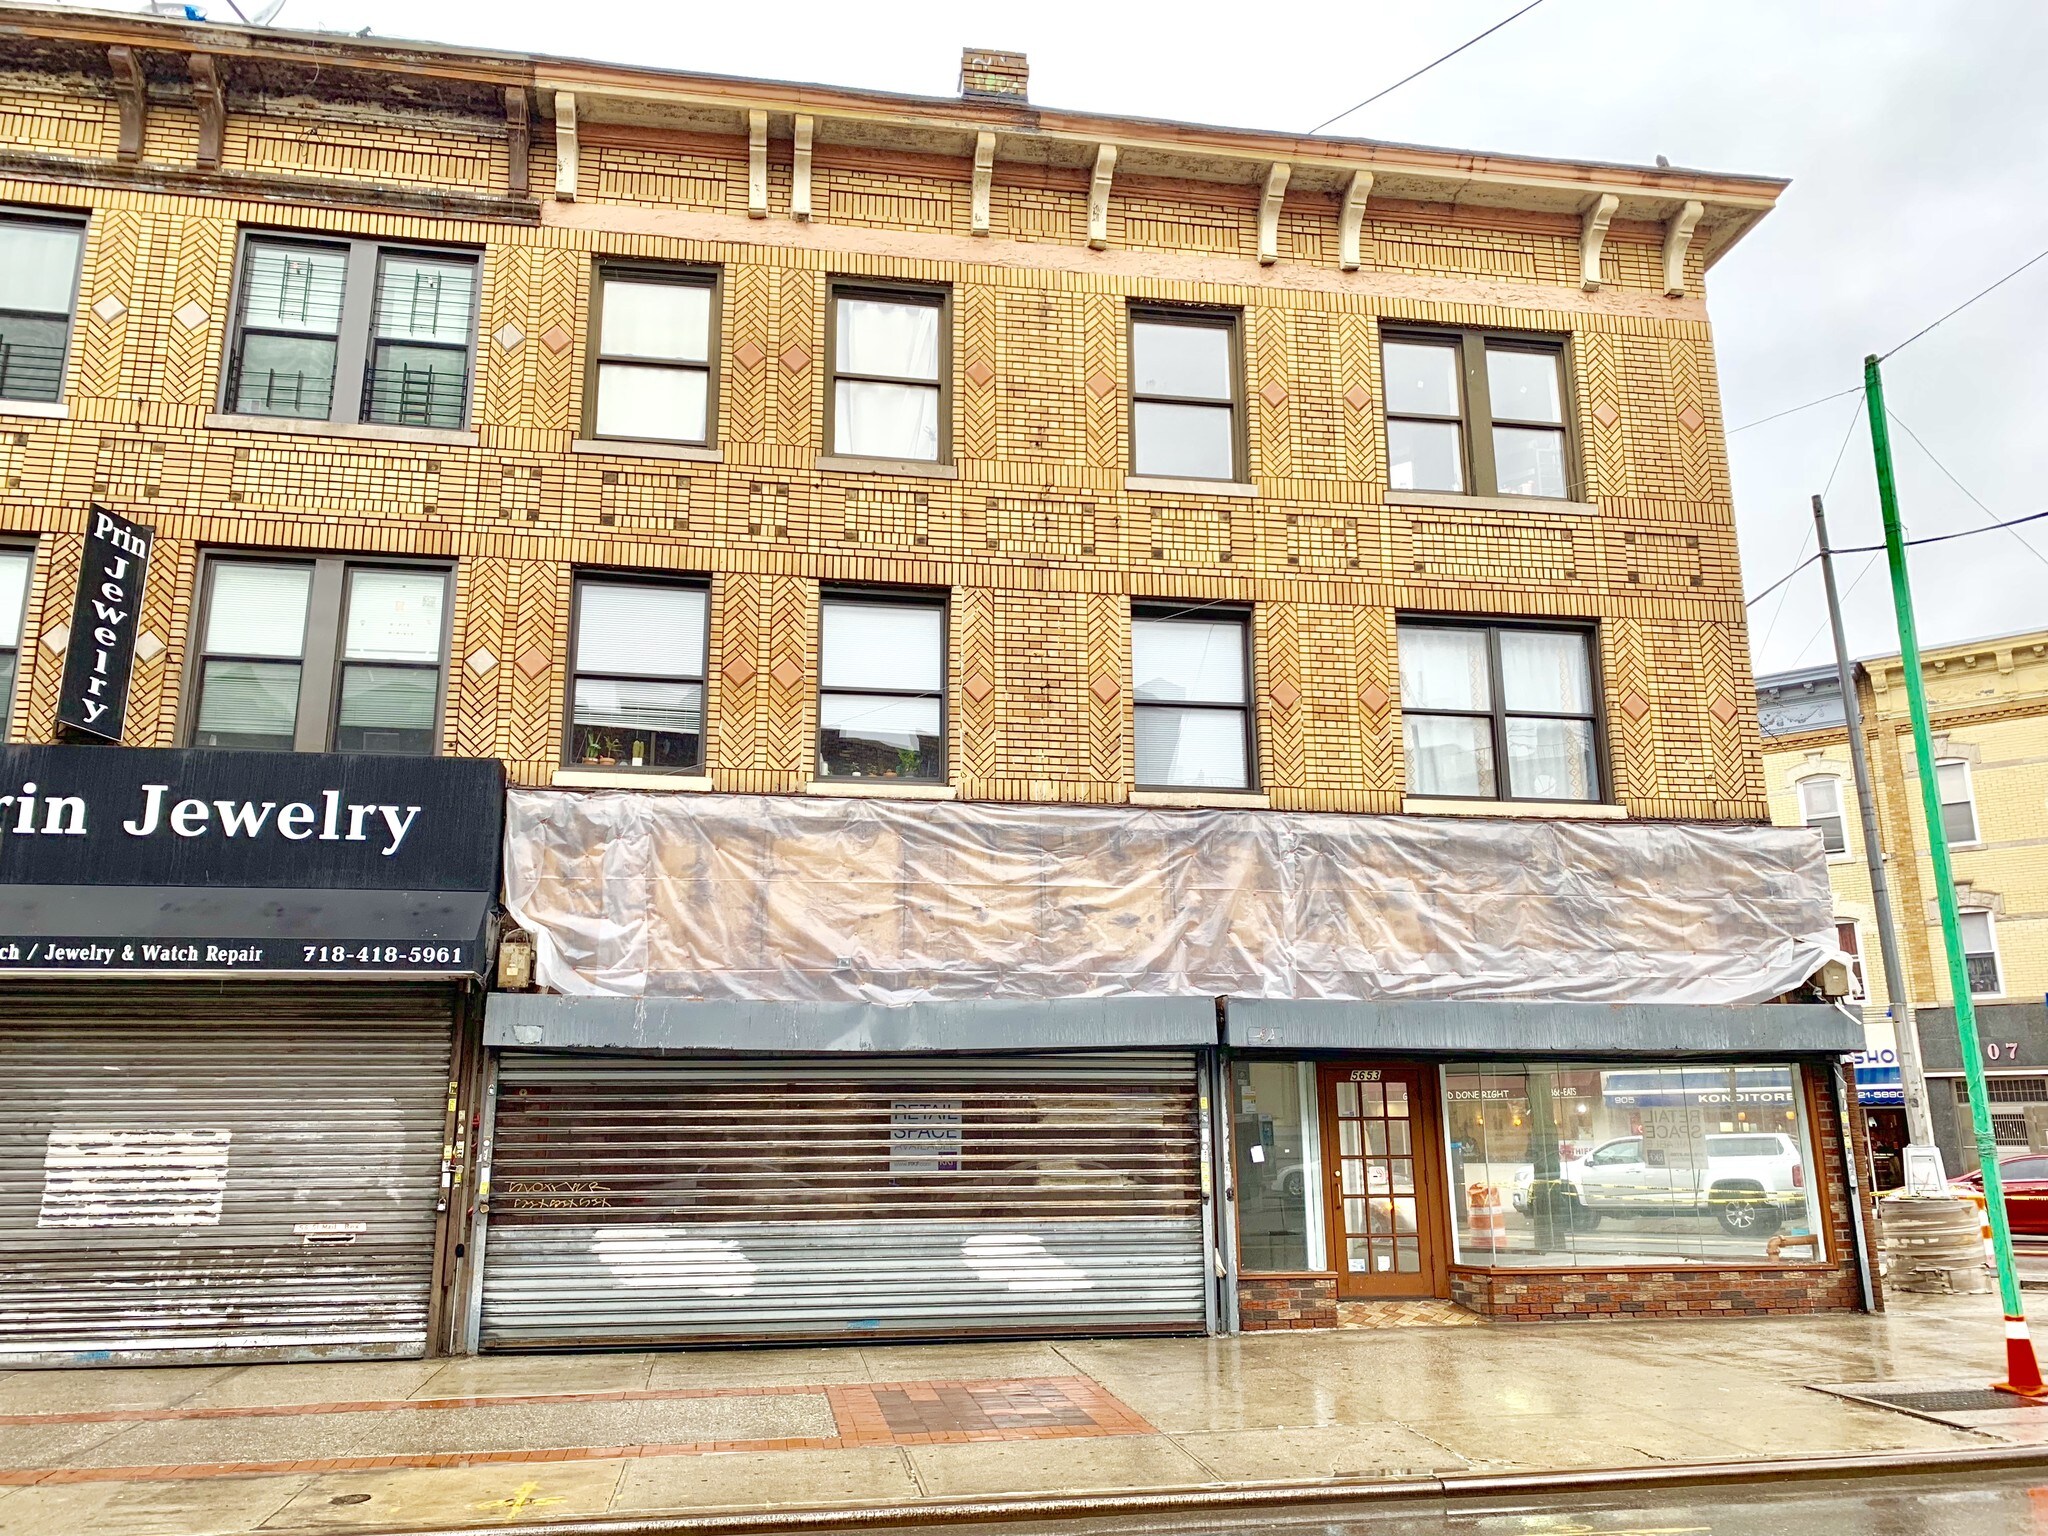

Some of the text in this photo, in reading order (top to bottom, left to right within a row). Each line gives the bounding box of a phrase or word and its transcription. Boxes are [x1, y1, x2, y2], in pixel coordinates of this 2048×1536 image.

[94, 512, 146, 559] Prin
[82, 555, 129, 723] Jewelry
[123, 784, 421, 856] Jewelry
[44, 944, 115, 965] Jewelry
[121, 944, 135, 961] &
[142, 945, 199, 962] Watch
[205, 945, 263, 965] Repair
[303, 946, 462, 963] 718-418-5961
[1351, 1070, 1380, 1080] 5653
[1456, 1090, 1480, 1100] DONE
[1482, 1090, 1509, 1099] RIGHT
